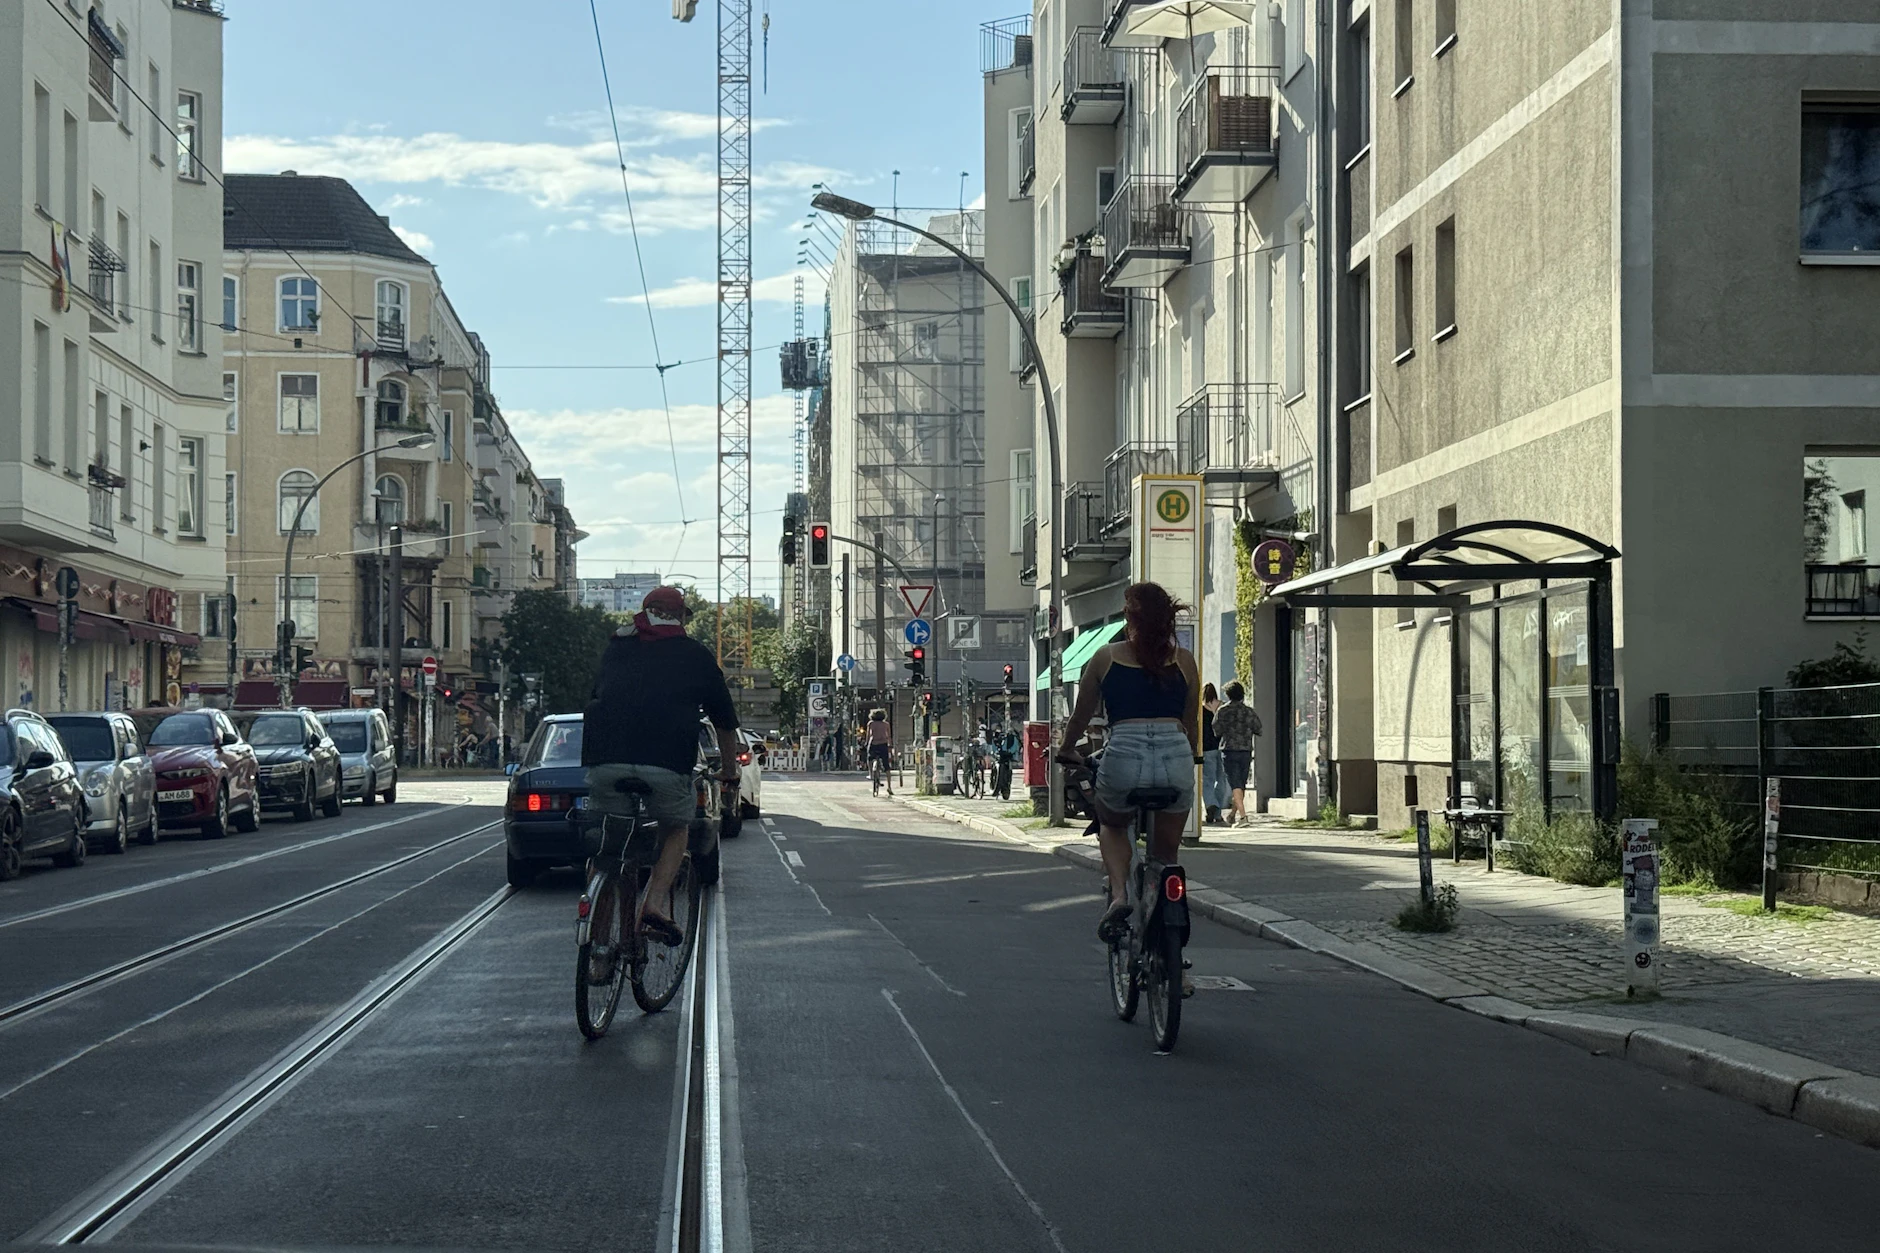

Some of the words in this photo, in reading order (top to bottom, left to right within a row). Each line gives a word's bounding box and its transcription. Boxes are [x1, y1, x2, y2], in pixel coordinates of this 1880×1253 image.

[1165, 497, 1181, 515] H
[959, 622, 969, 637] P
[813, 685, 820, 693] P
[176, 790, 190, 799] 688
